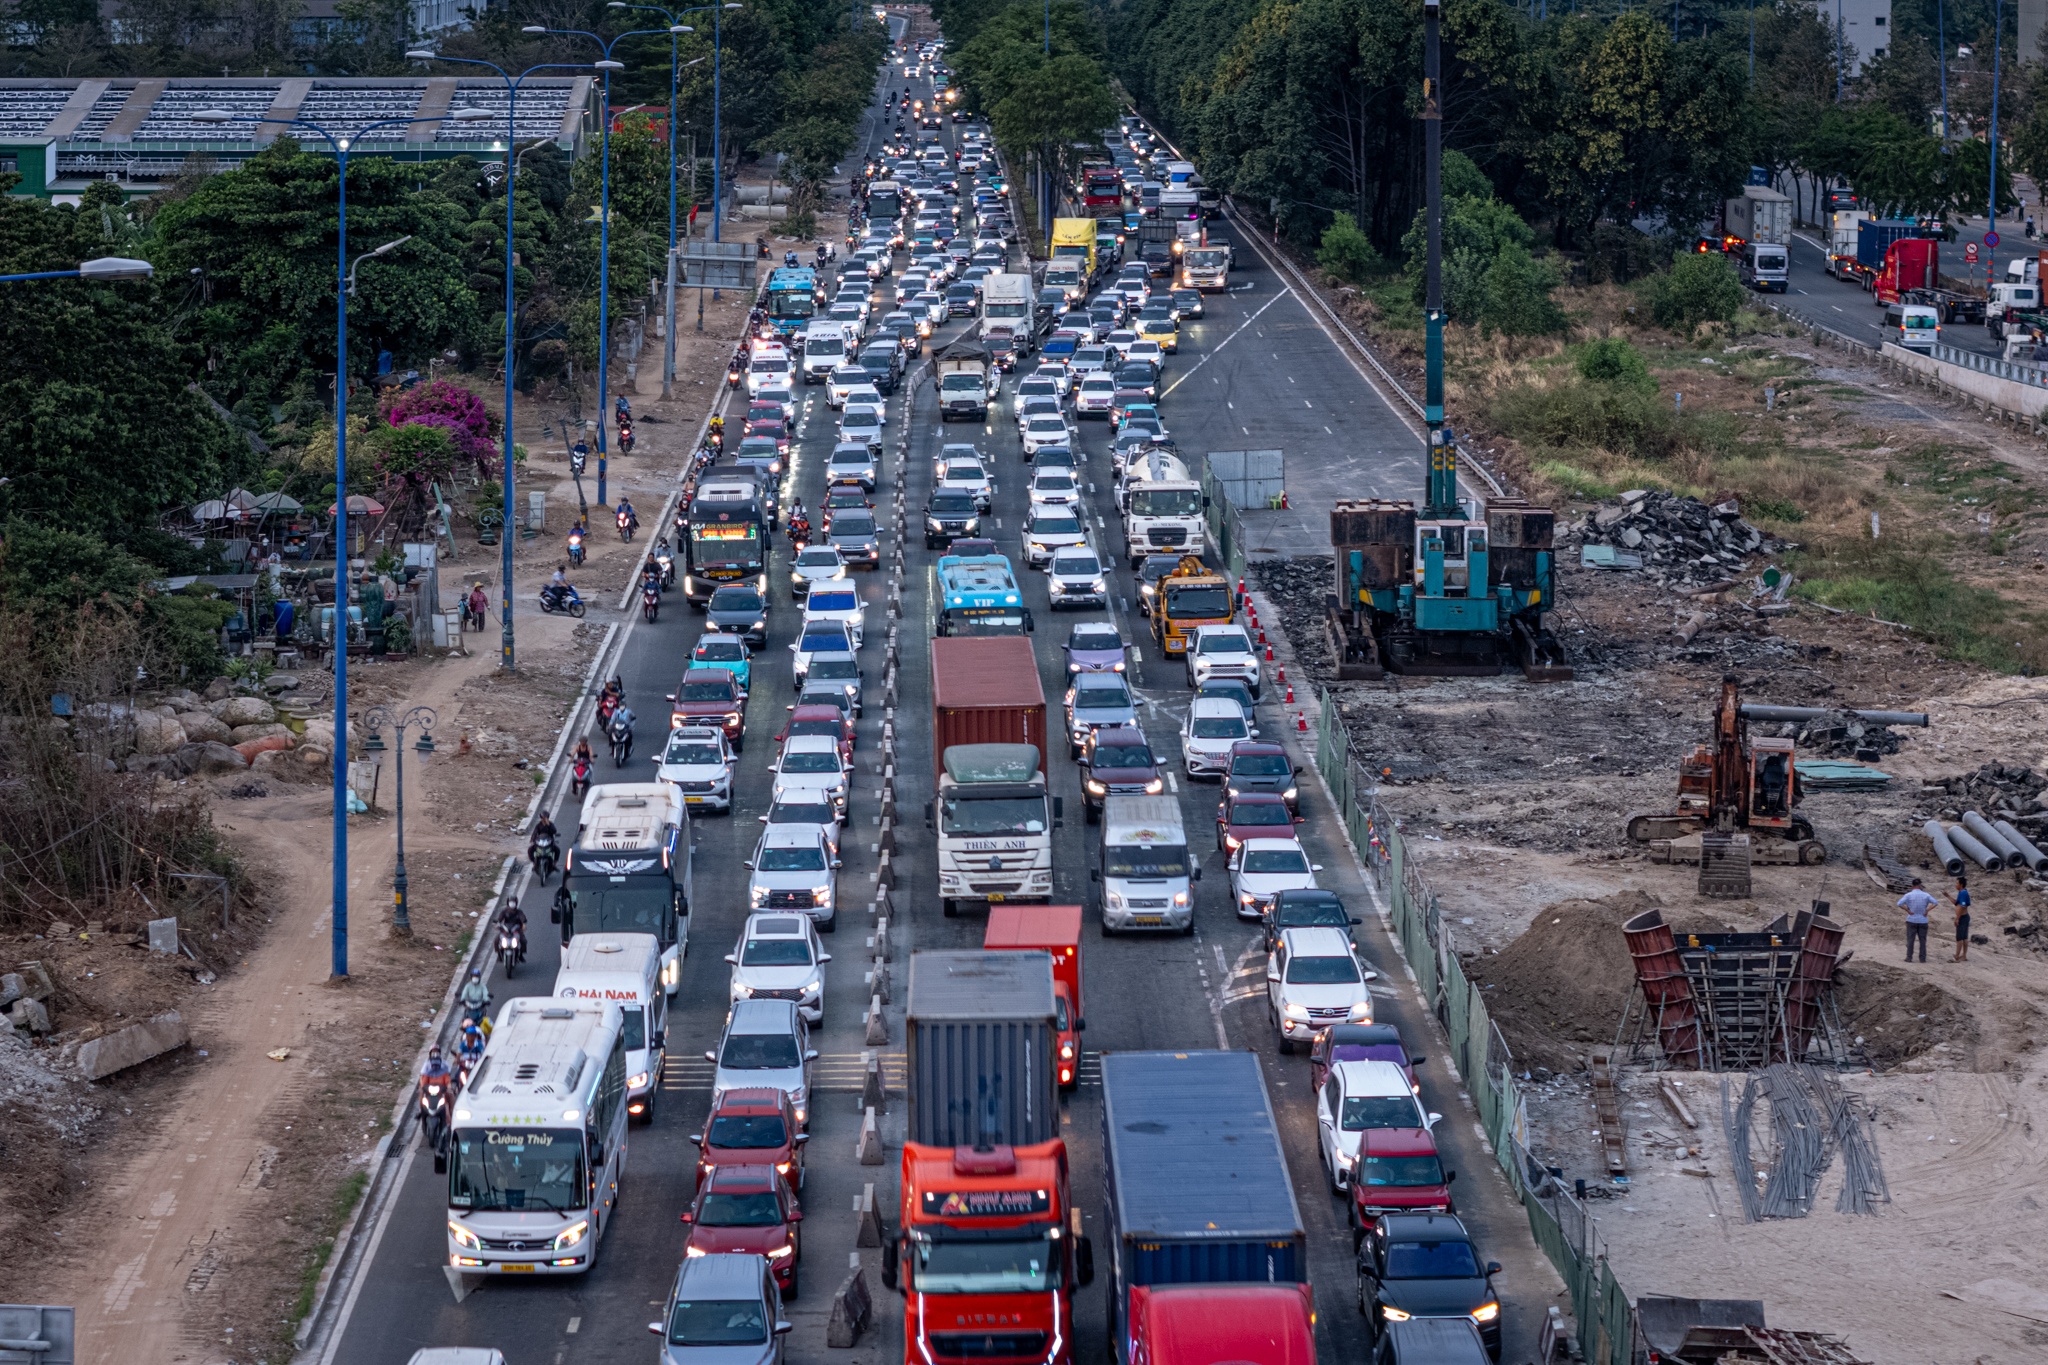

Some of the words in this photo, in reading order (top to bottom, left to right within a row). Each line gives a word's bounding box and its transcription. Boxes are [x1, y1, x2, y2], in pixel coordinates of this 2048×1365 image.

[973, 598, 996, 607] VIP
[1004, 840, 1026, 849] ANH
[609, 859, 628, 868] VIP
[578, 988, 602, 999] HẢI
[605, 989, 637, 1000] NAM
